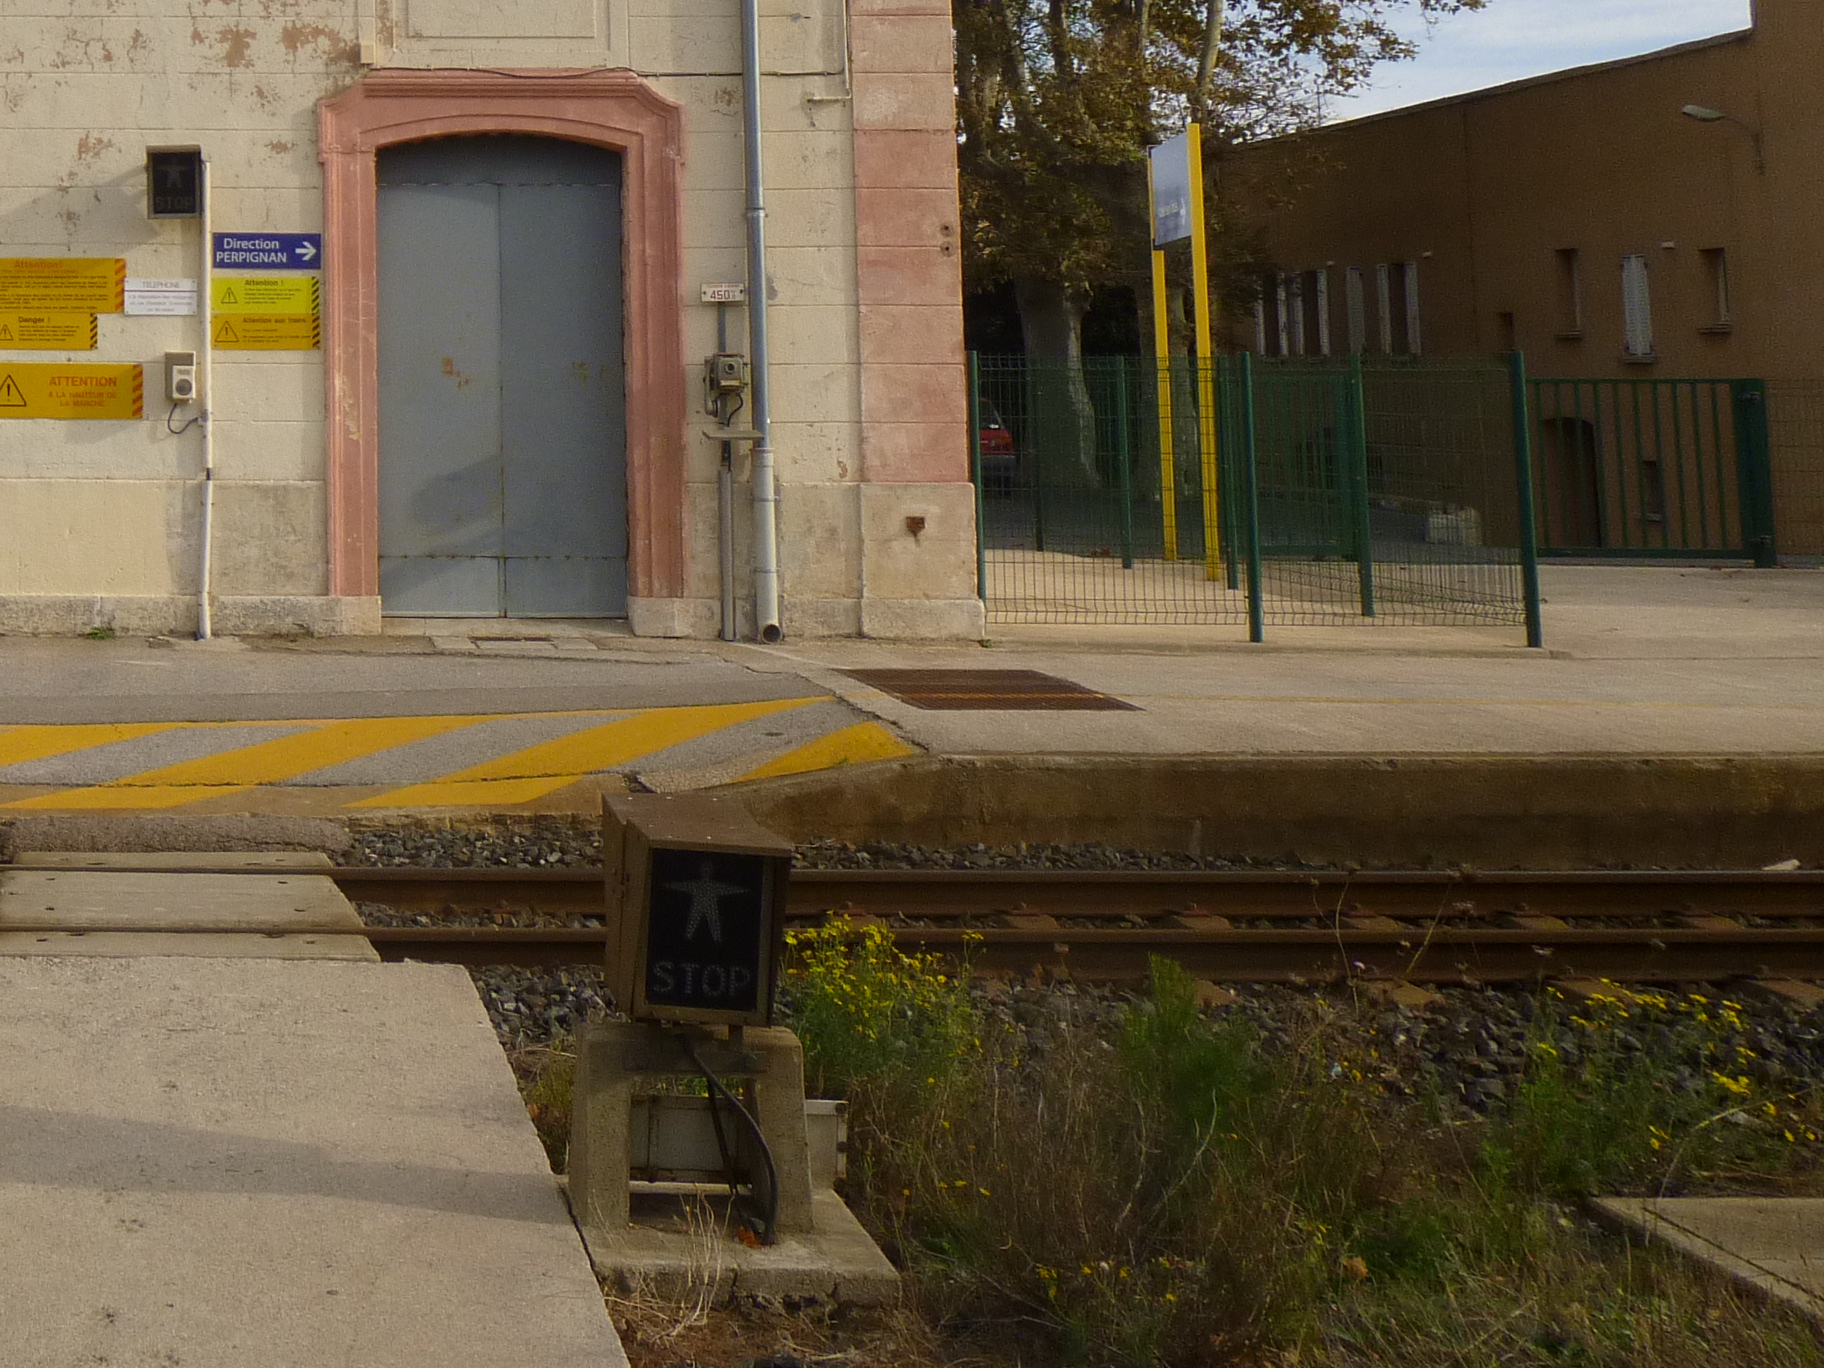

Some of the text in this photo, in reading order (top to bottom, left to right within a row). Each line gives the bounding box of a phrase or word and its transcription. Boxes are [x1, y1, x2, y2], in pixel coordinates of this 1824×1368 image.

[223, 238, 279, 249] Direction
[216, 251, 287, 263] PERPIGNAN
[710, 289, 730, 300] 450
[18, 316, 45, 325] Danger
[49, 376, 117, 387] ATTENTION
[652, 960, 751, 997] STOP
